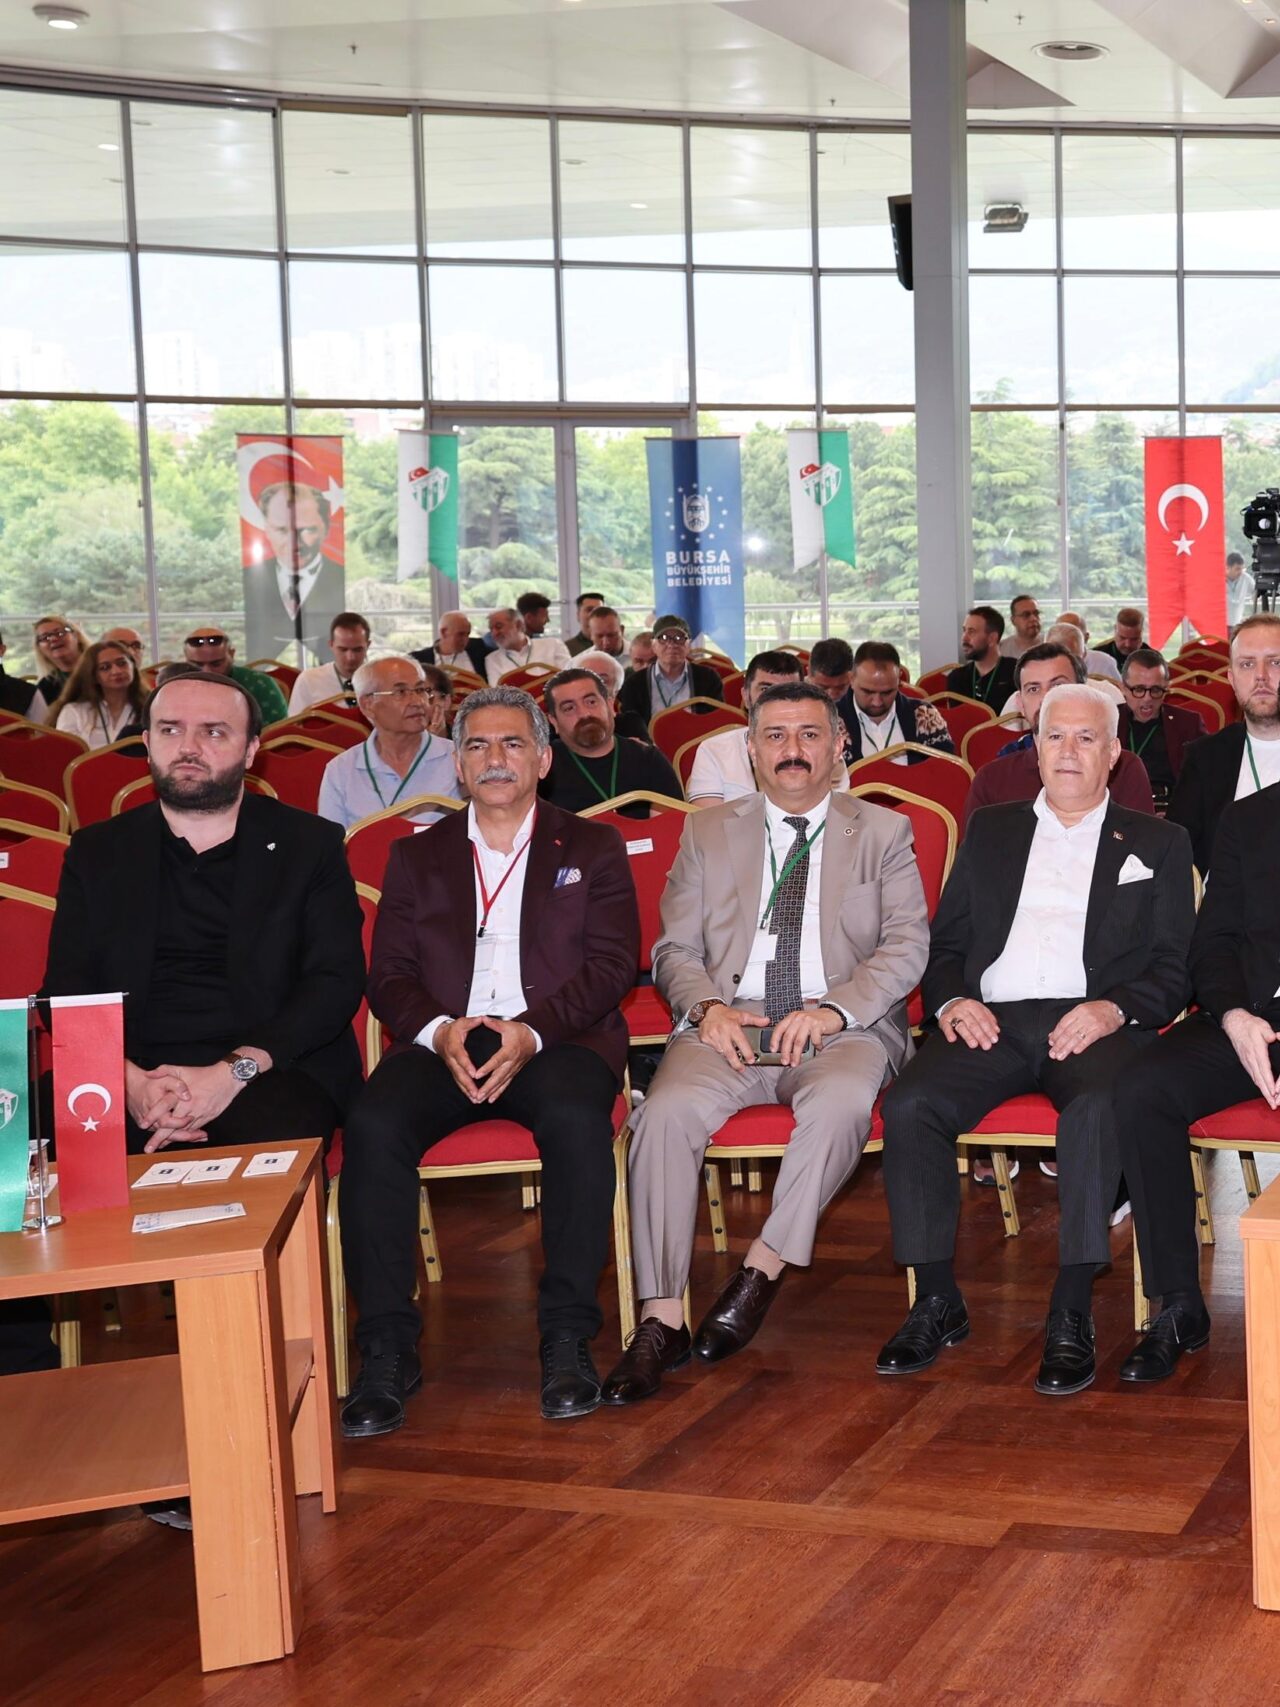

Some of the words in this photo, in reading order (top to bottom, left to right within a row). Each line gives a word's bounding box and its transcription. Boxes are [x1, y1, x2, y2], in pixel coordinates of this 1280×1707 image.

[665, 550, 731, 565] BURSA
[666, 563, 731, 576] BÜYÜKŞEHİR
[667, 575, 732, 587] BELEDİYESİ
